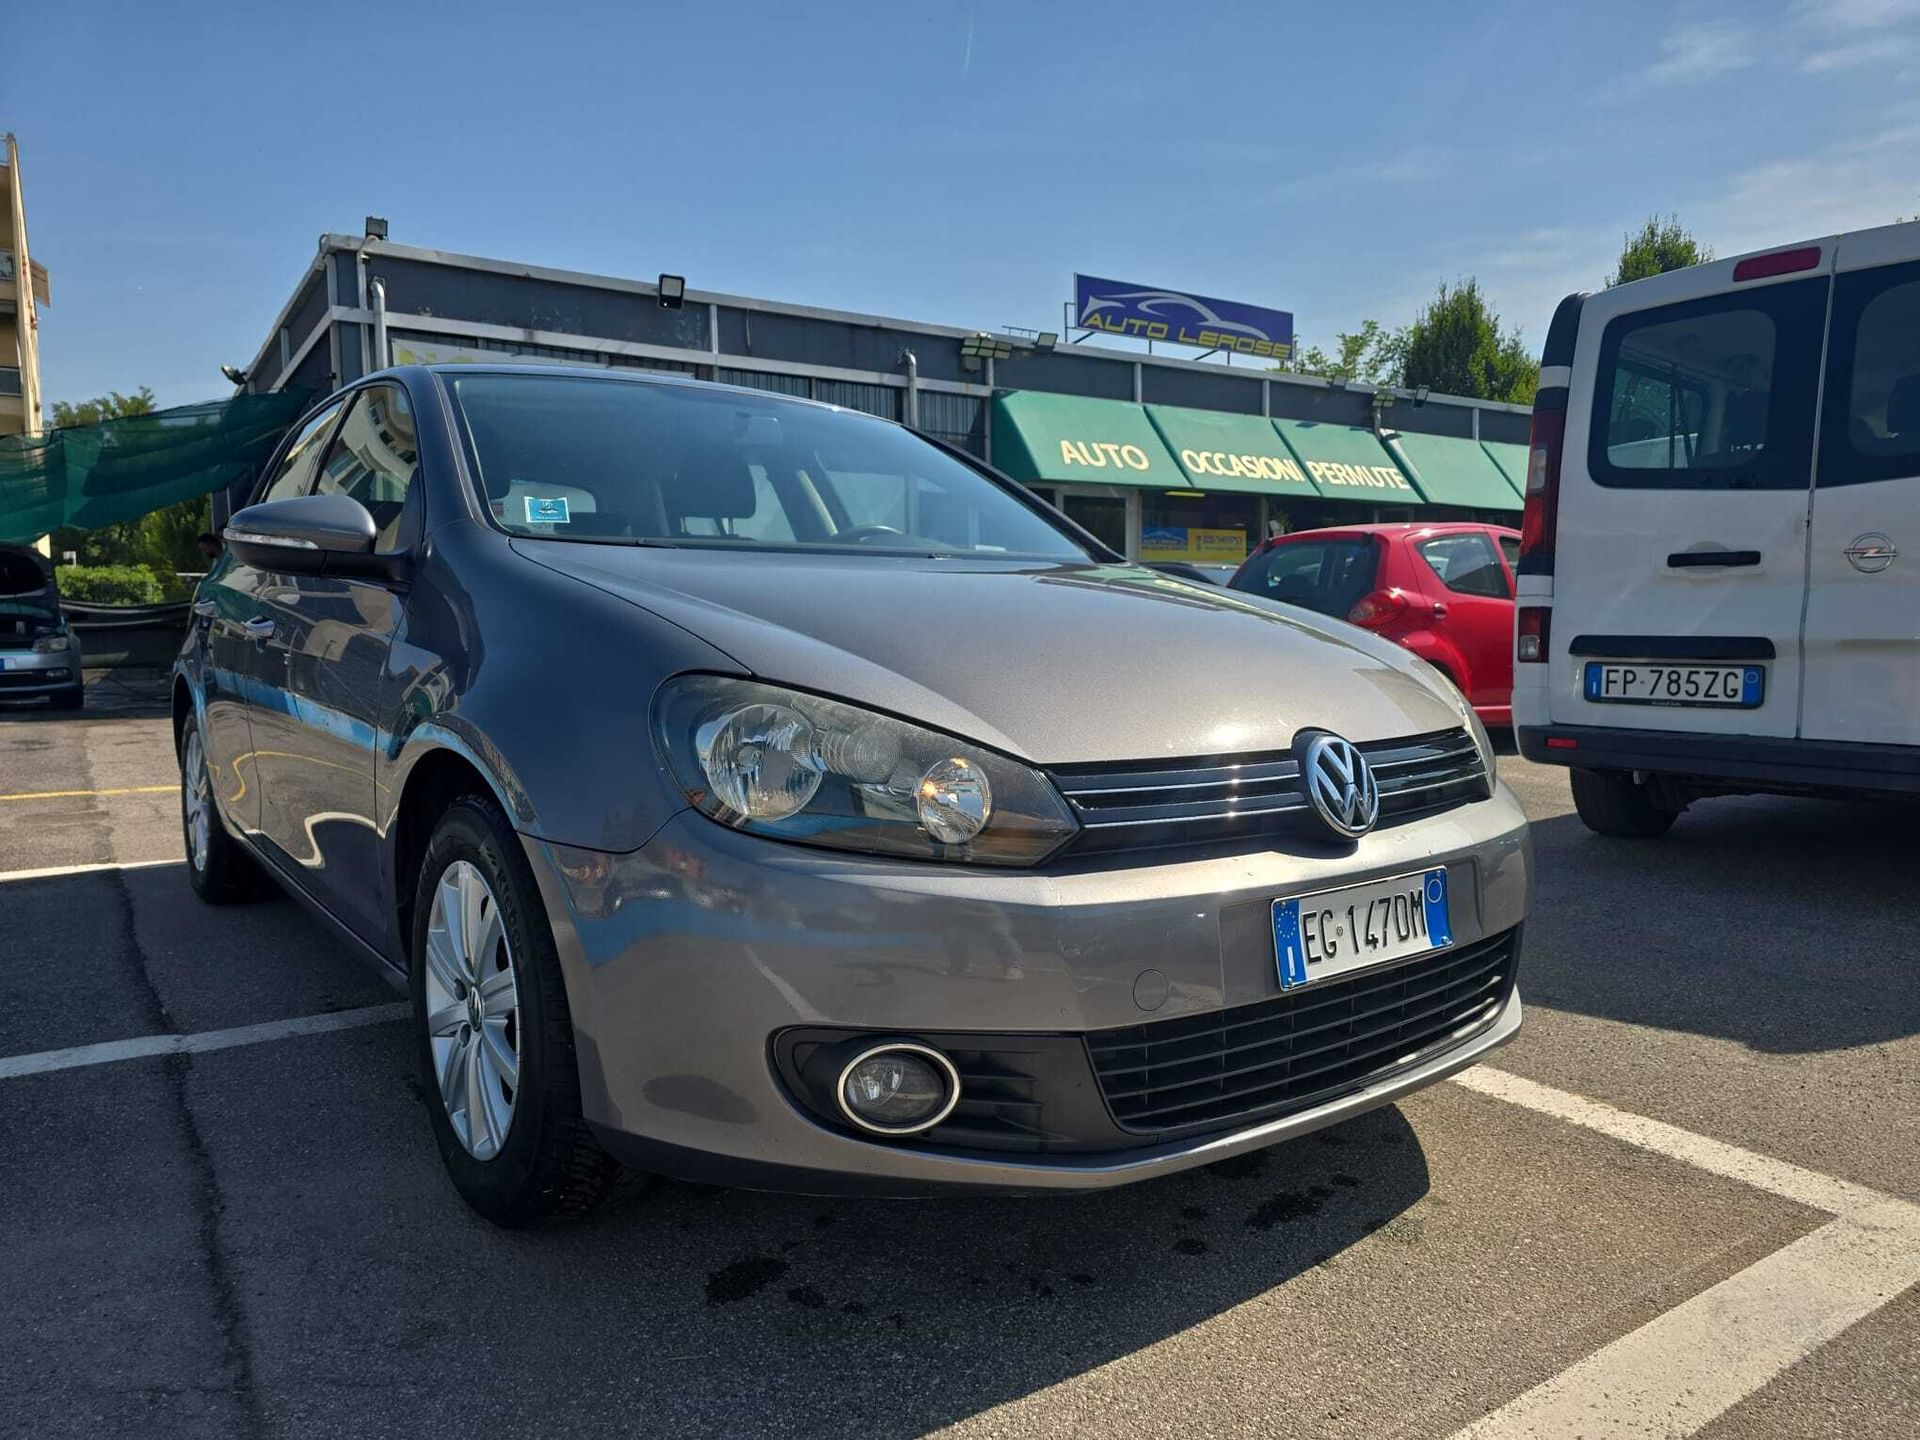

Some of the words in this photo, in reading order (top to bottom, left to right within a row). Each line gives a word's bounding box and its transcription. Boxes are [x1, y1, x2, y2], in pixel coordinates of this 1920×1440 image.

[1084, 313, 1169, 337] AUTO
[1179, 327, 1293, 357] LEROSE
[1060, 440, 1150, 470] AUTO
[1181, 450, 1305, 482] OCCASIONI
[1306, 461, 1411, 490] PERMUTE
[1347, 888, 1426, 955] 147DM
